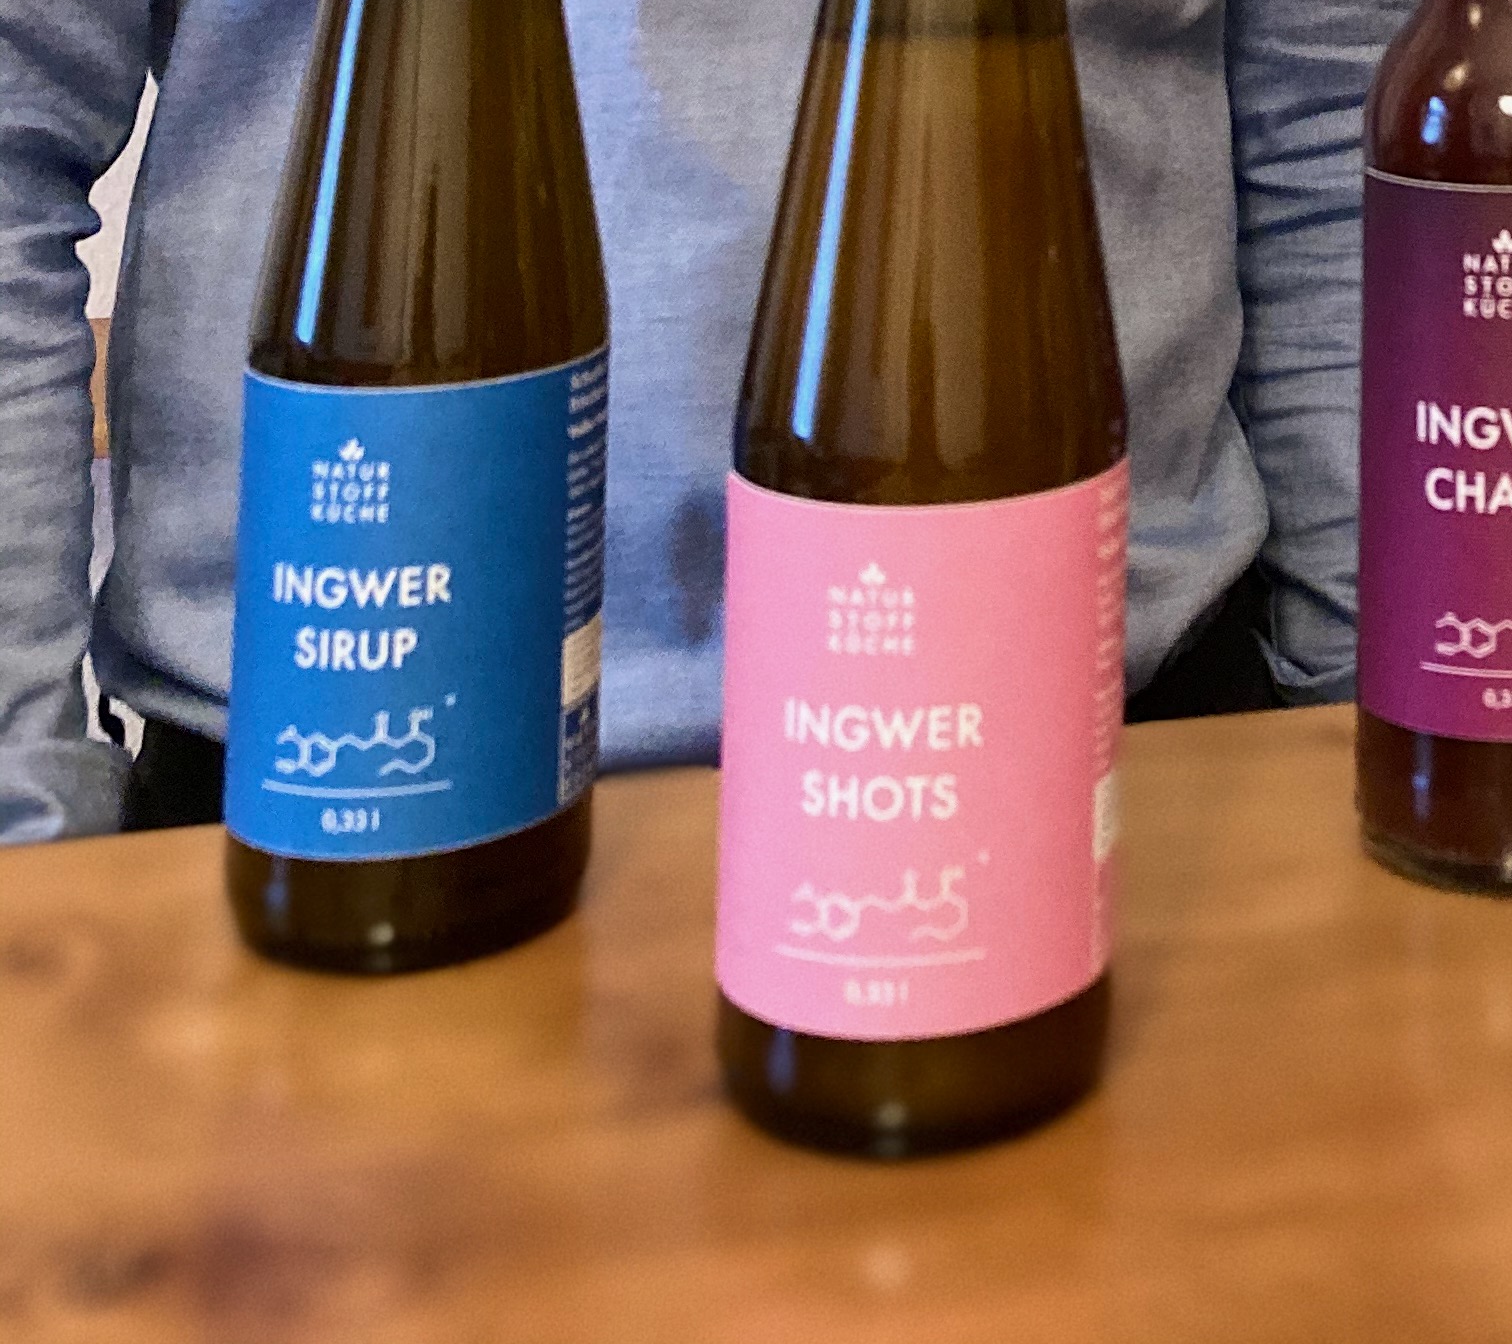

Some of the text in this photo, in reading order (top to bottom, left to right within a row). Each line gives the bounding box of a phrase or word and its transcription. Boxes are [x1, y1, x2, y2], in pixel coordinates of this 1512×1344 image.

[272, 561, 452, 610] INGWER
[294, 626, 418, 672] SIRUP
[784, 697, 983, 752] INGWER
[801, 769, 958, 821] SHOTS
